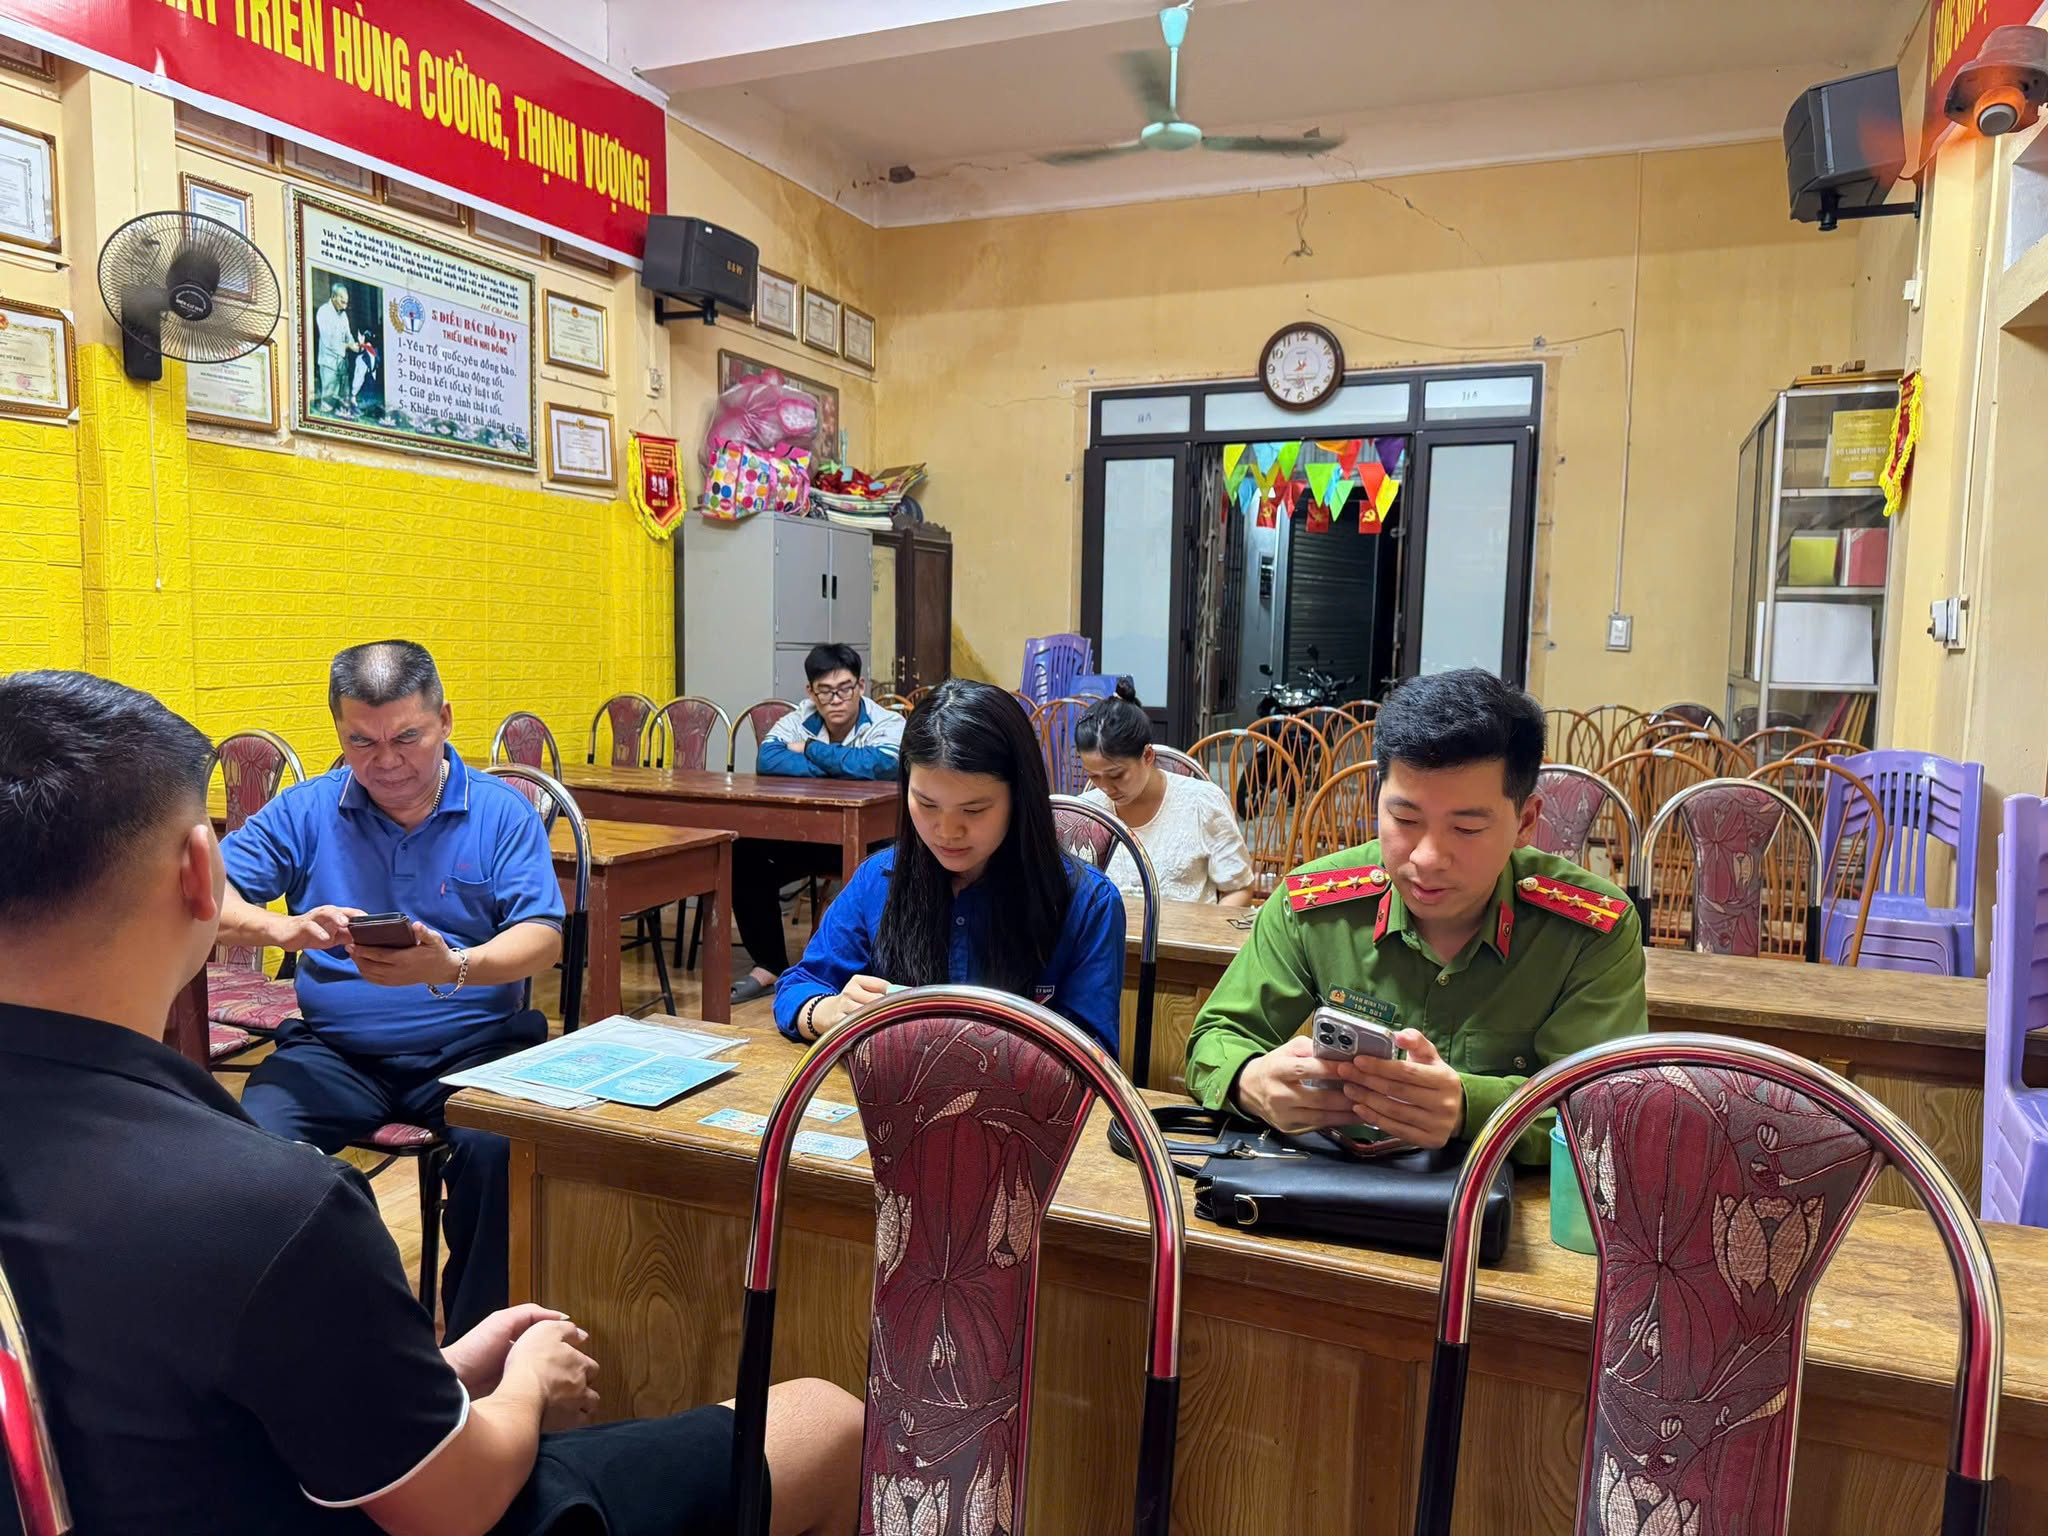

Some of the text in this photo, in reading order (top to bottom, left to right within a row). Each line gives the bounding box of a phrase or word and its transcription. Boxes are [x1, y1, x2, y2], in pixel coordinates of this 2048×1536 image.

[332, 1, 412, 111] HÙNG
[418, 48, 510, 161] CƯỜNG,
[513, 95, 578, 185] THỊNH
[581, 127, 651, 214] VƯỢNG!
[322, 228, 336, 240] Việt
[338, 234, 352, 244] Nam
[384, 240, 397, 251] Việt
[371, 254, 382, 266] hay
[464, 318, 482, 333] BÁC
[484, 321, 496, 337] HỒ
[479, 340, 489, 350] NHI
[409, 354, 426, 370] Học
[428, 360, 441, 374] tập
[471, 371, 490, 386] động
[409, 370, 432, 385] Đoàn
[433, 375, 447, 388] kết
[474, 386, 489, 399] luật
[410, 401, 438, 416] Khiêm
[442, 394, 452, 406] vệ
[455, 396, 471, 408] sinh
[472, 401, 487, 413] thật
